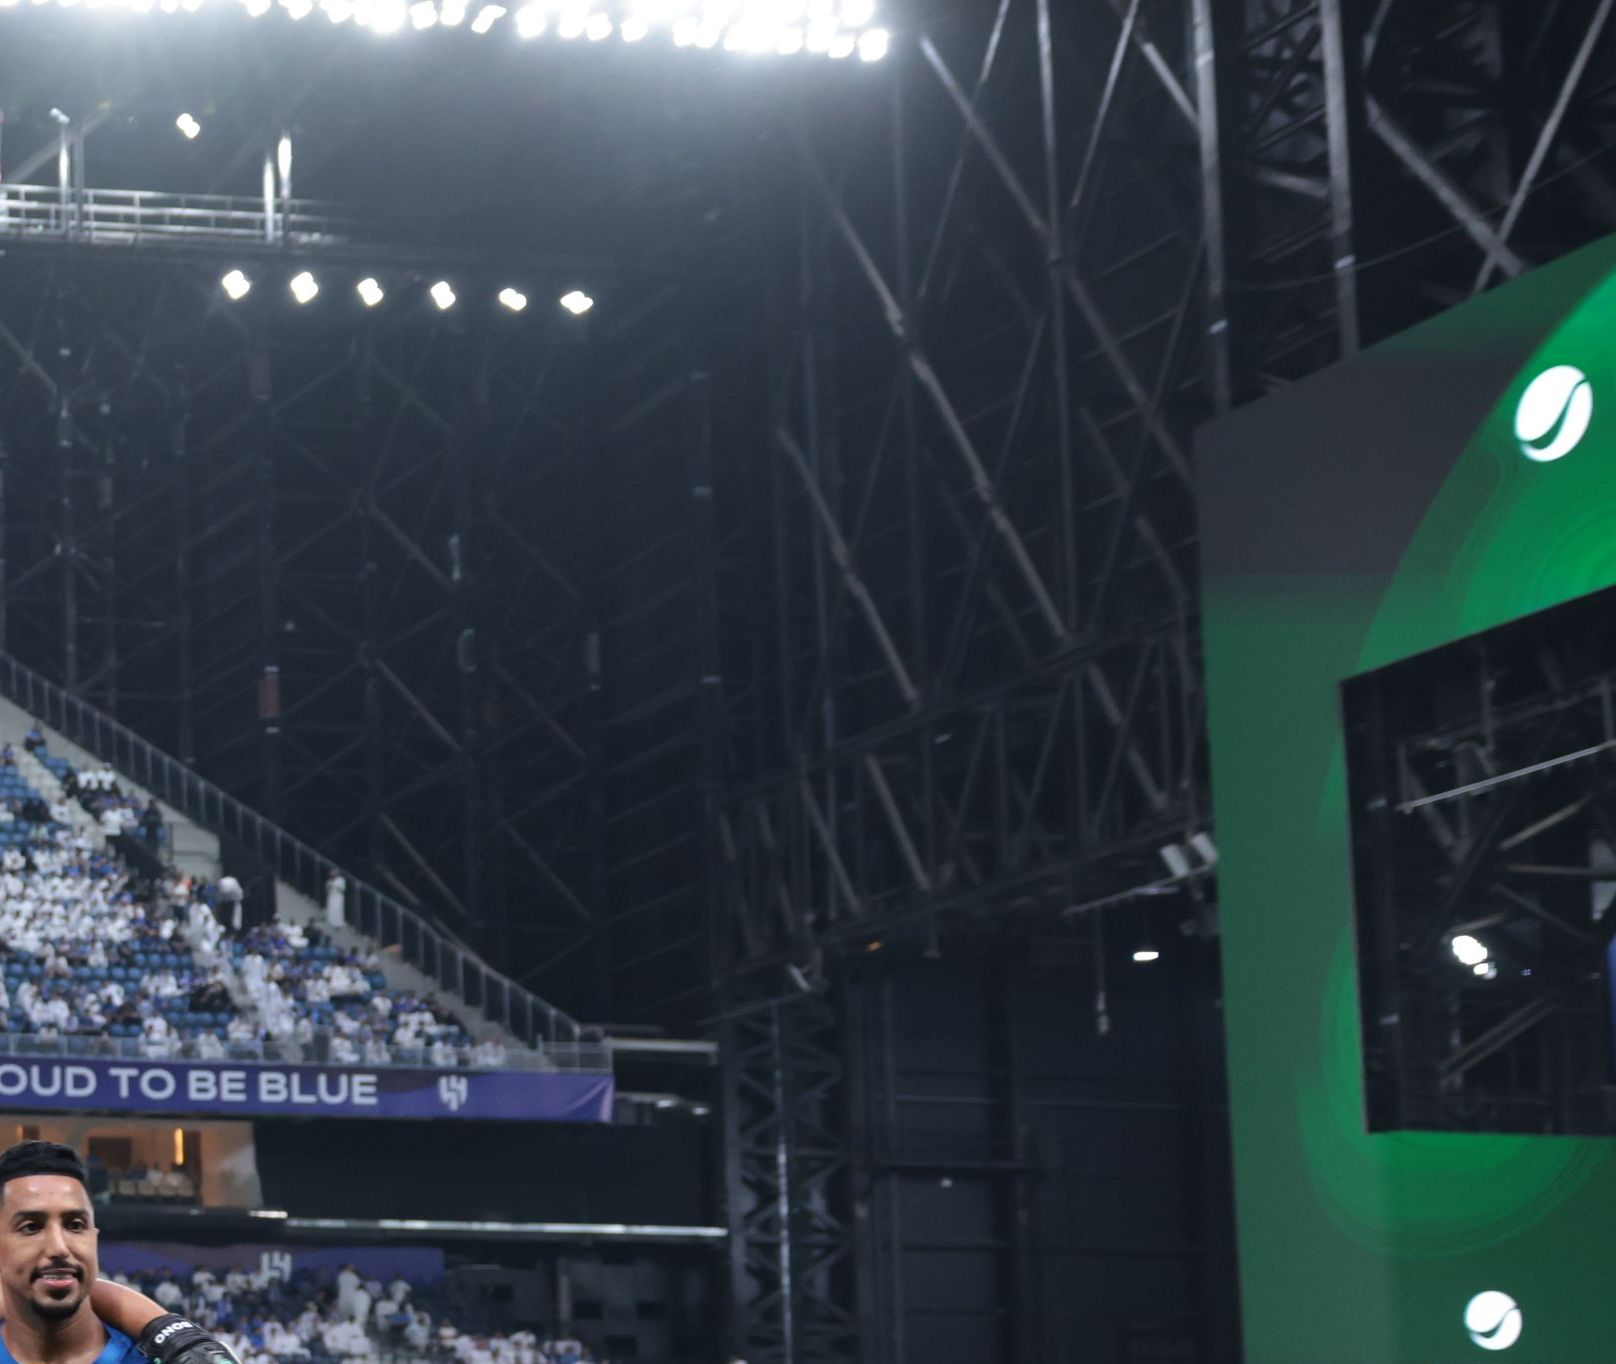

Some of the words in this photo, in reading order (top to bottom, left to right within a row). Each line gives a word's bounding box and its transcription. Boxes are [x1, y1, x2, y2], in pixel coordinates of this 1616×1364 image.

[109, 1067, 176, 1101] TO
[187, 1070, 248, 1102] BE
[258, 1072, 379, 1105] BLUE
